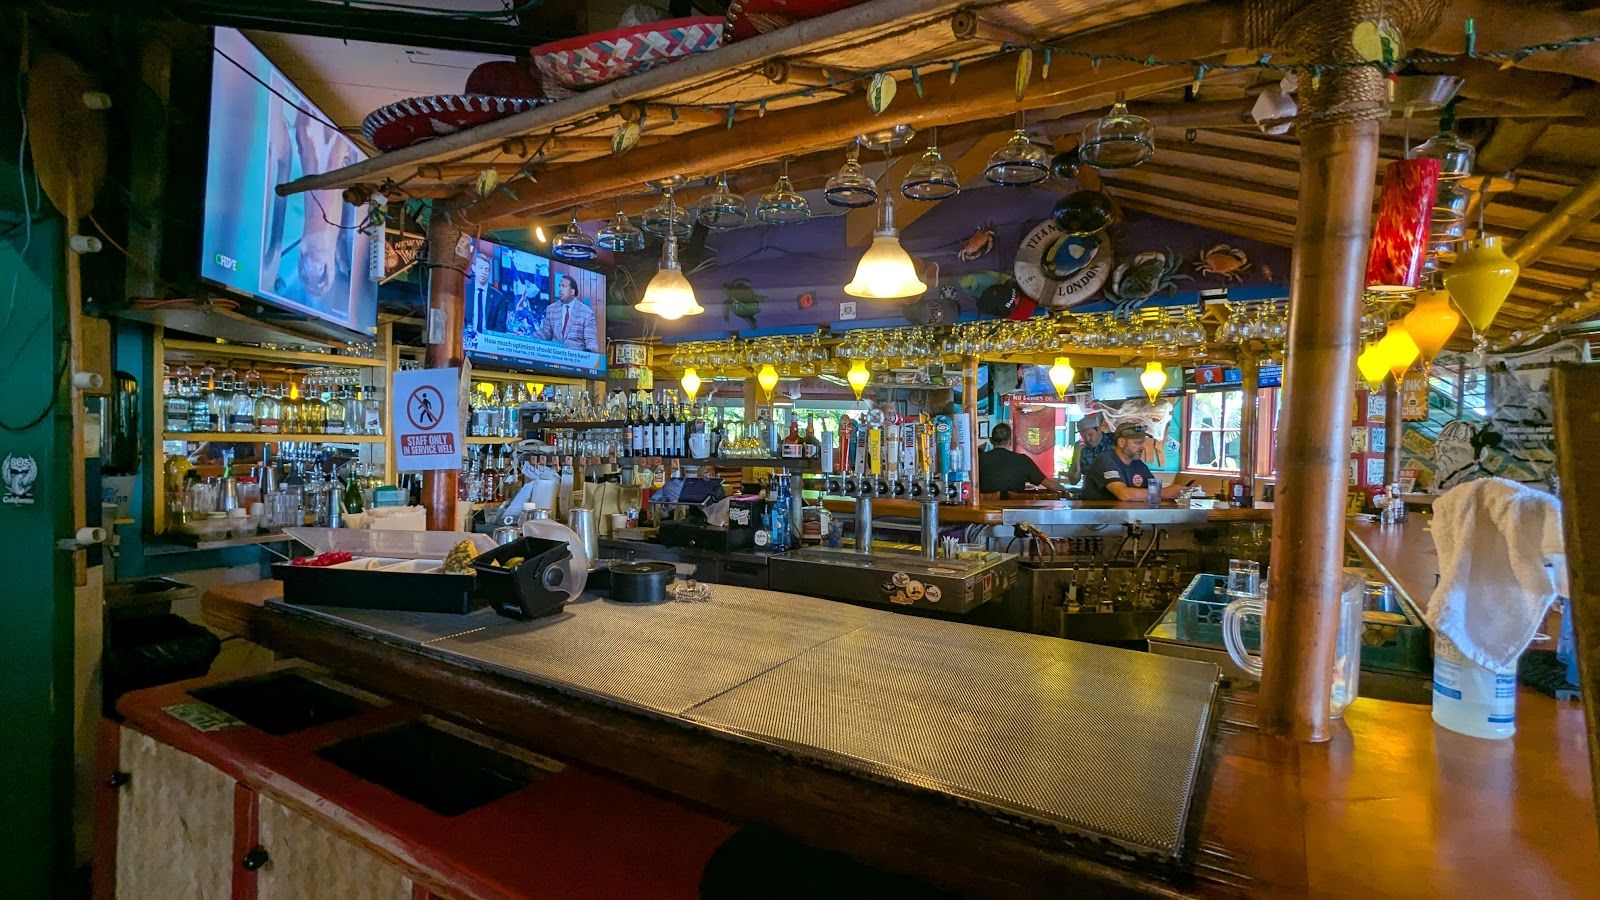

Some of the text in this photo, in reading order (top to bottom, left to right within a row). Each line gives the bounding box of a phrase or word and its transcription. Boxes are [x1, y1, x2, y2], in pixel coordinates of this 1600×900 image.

[1025, 224, 1057, 249] TITAN
[1058, 264, 1101, 296] LONDON
[497, 340, 512, 348] much
[513, 343, 536, 351] optimism
[536, 345, 552, 353] should
[552, 348, 567, 357] Giants
[407, 434, 448, 446] STAFF ONLY
[403, 443, 454, 455] IN SERVICE WELL
